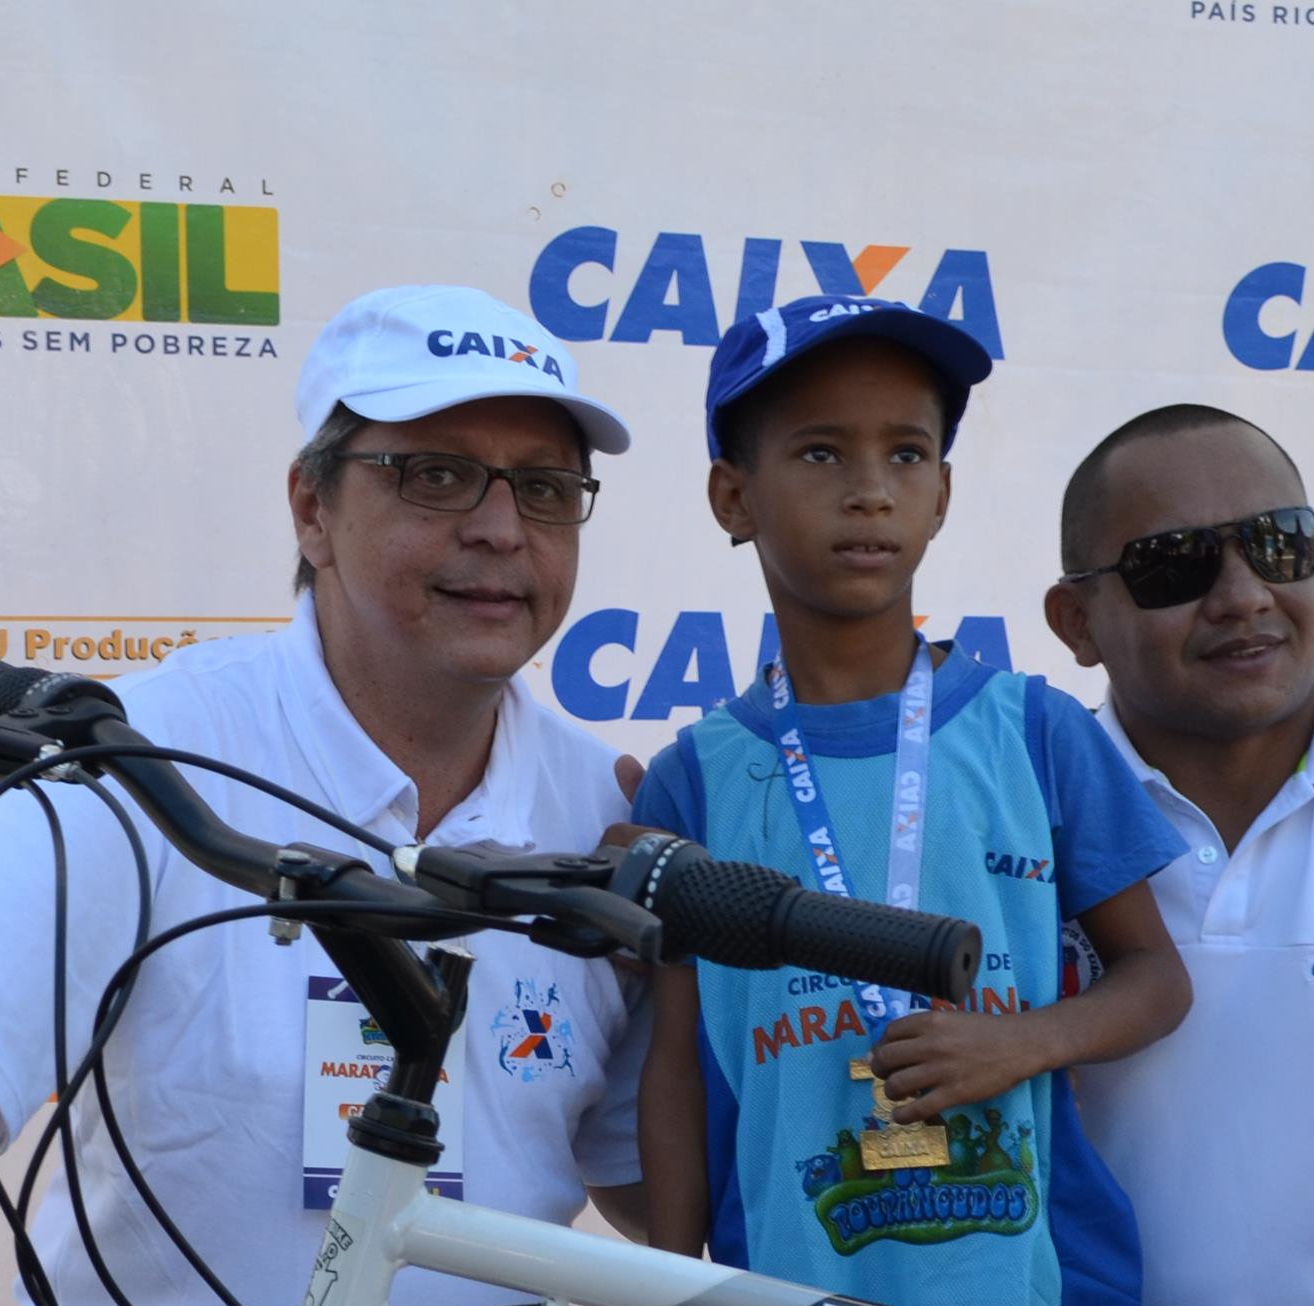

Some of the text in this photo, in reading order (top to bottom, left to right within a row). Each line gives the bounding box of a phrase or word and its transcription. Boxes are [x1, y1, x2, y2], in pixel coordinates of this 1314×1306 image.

[1191, 0, 1256, 23] PAÍS
[16, 168, 275, 196] FEDERAL
[528, 225, 1005, 361] CAIXA
[809, 303, 880, 322] CAI
[22, 330, 91, 353] SEM
[111, 332, 278, 359] POBREZA
[427, 329, 565, 385] CAIXA
[25, 629, 232, 664] Produçõ
[552, 608, 1014, 722] CAA
[780, 728, 816, 803] CAIXA
[808, 826, 850, 897] AIXA
[988, 953, 1011, 971] DE
